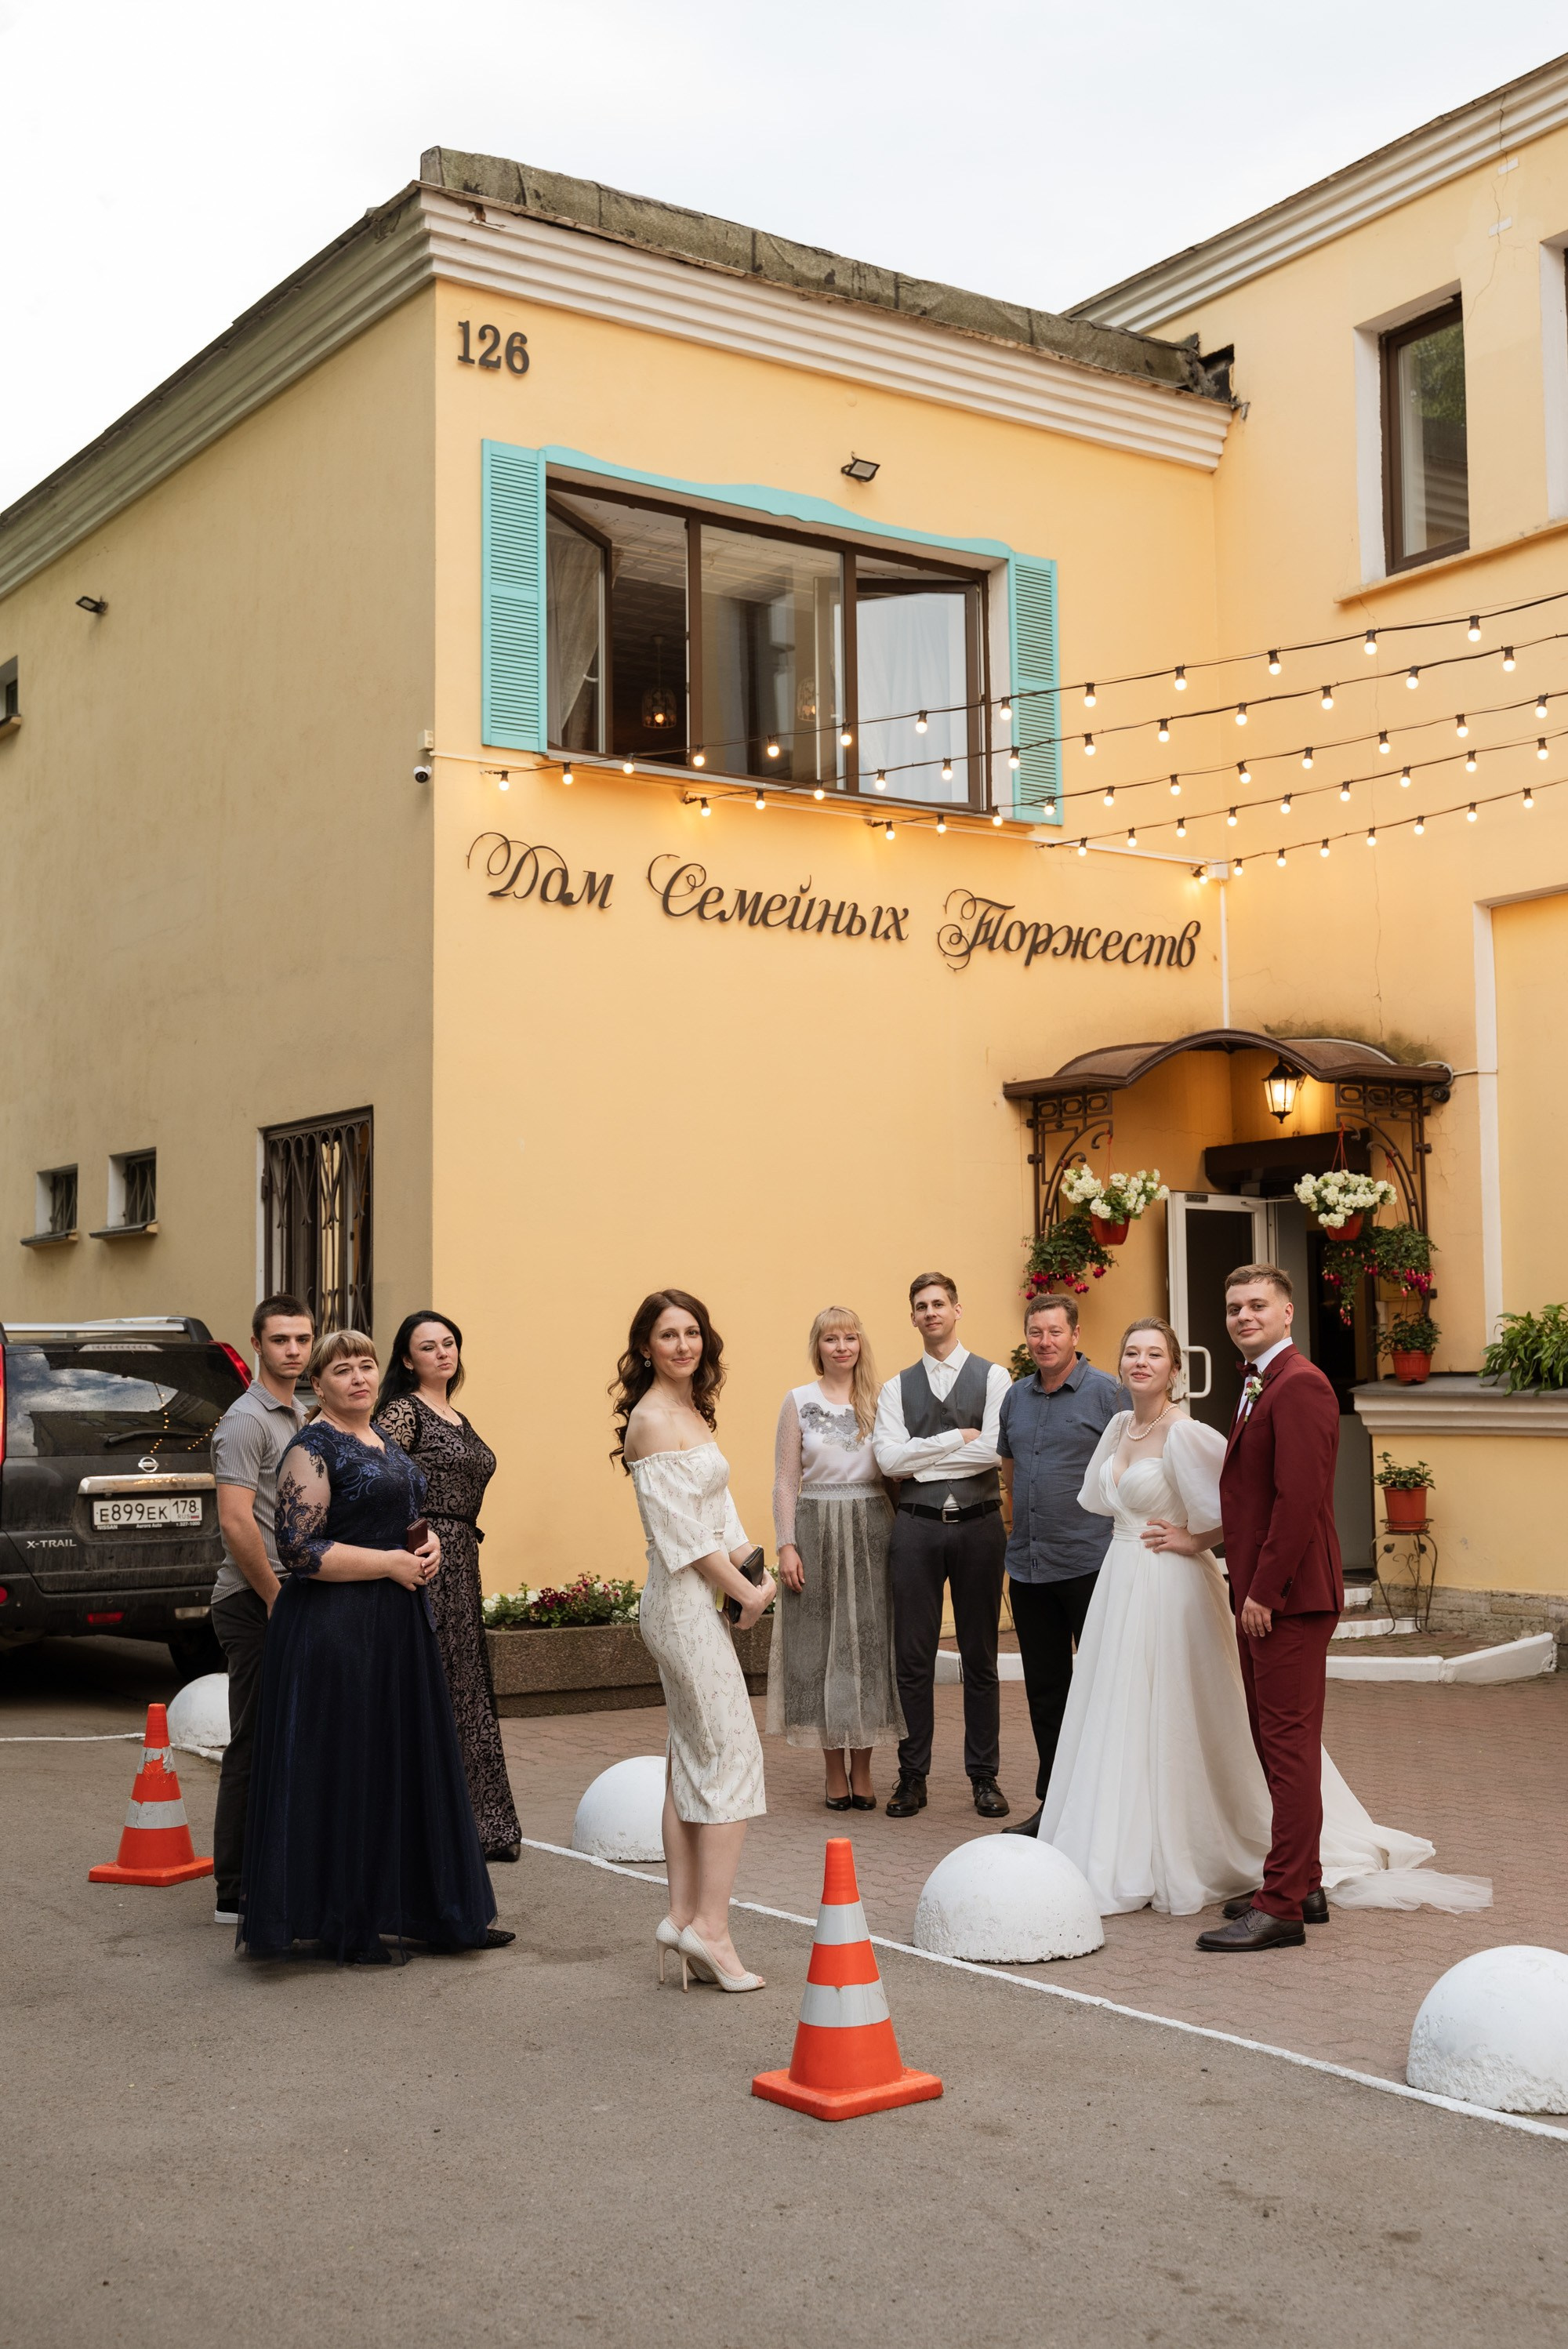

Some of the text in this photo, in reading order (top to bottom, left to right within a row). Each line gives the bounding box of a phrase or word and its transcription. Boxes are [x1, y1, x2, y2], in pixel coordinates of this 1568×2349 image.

[457, 320, 530, 375] 126
[465, 831, 1202, 971] Дом Семейных Торжеств
[172, 1499, 198, 1513] 178
[26, 1538, 77, 1549] X-TRAIL
